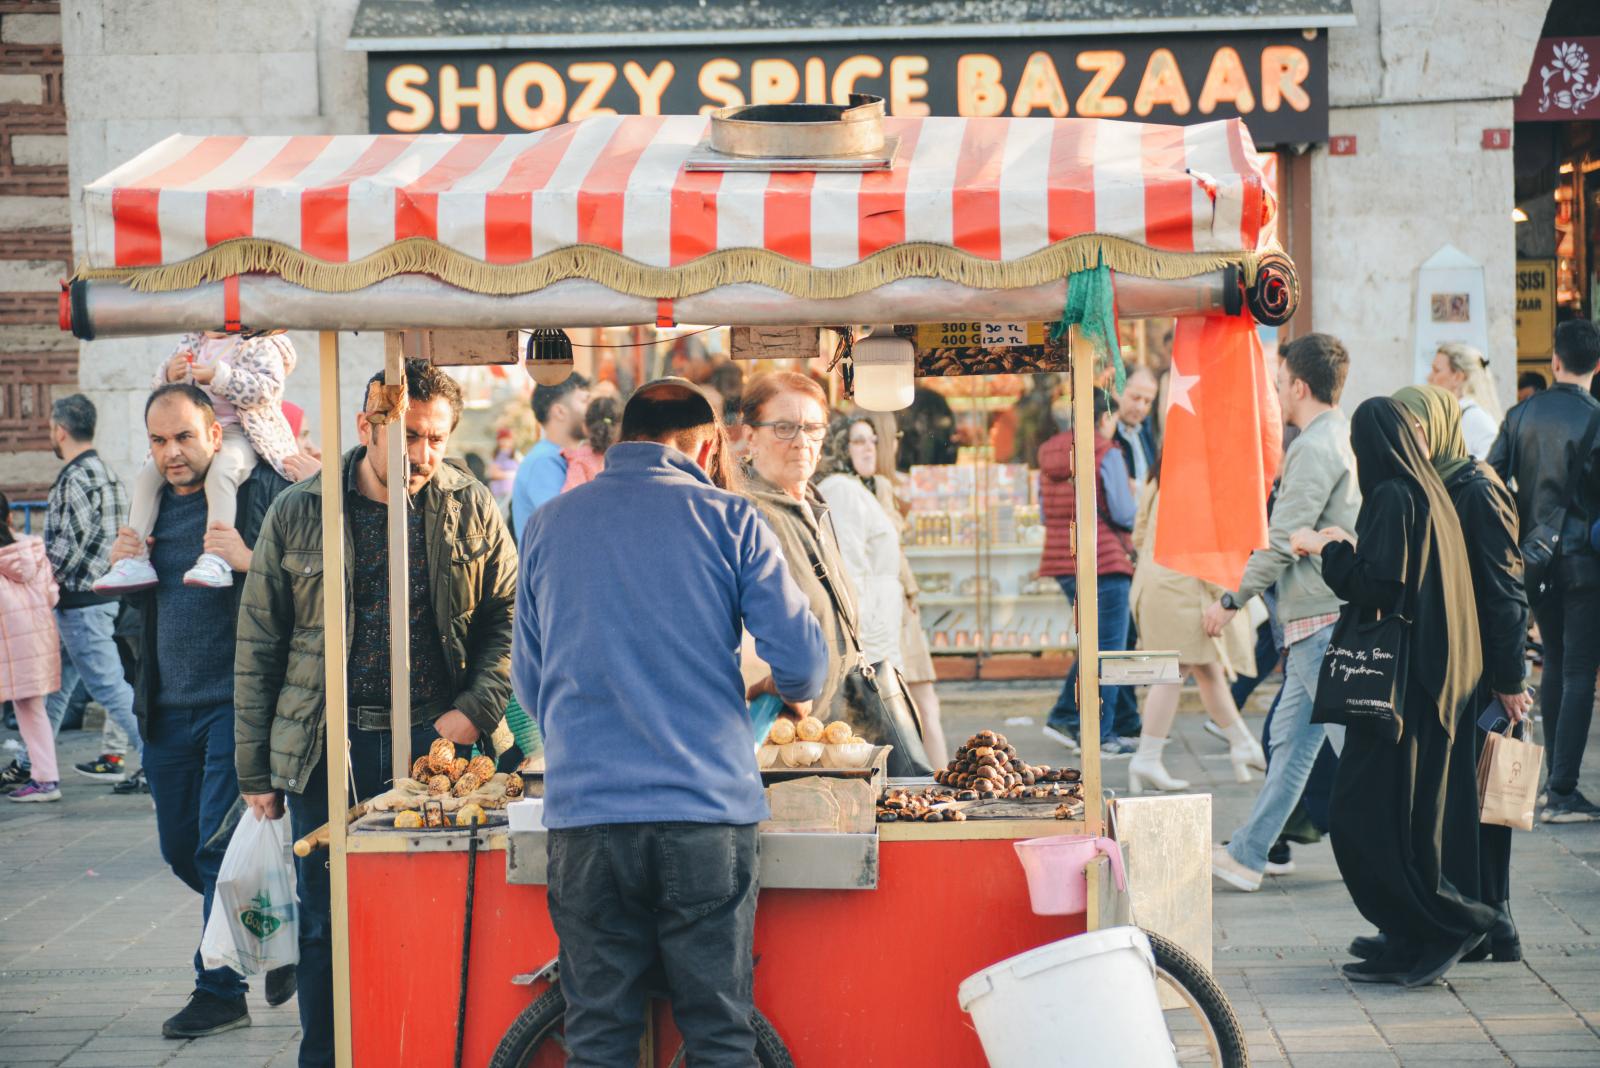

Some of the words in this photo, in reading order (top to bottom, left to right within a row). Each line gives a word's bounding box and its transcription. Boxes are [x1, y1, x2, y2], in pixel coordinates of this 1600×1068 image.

[386, 60, 675, 132] SHOZY
[698, 55, 930, 117] SPICE
[957, 45, 1310, 117] BAZAAR
[941, 322, 967, 333] 300
[971, 322, 982, 332] G
[985, 323, 1002, 334] 90
[1007, 323, 1024, 333] TL
[940, 334, 967, 345] 400
[971, 333, 982, 344] G
[982, 336, 1005, 345] 120
[1008, 335, 1024, 344] TL
